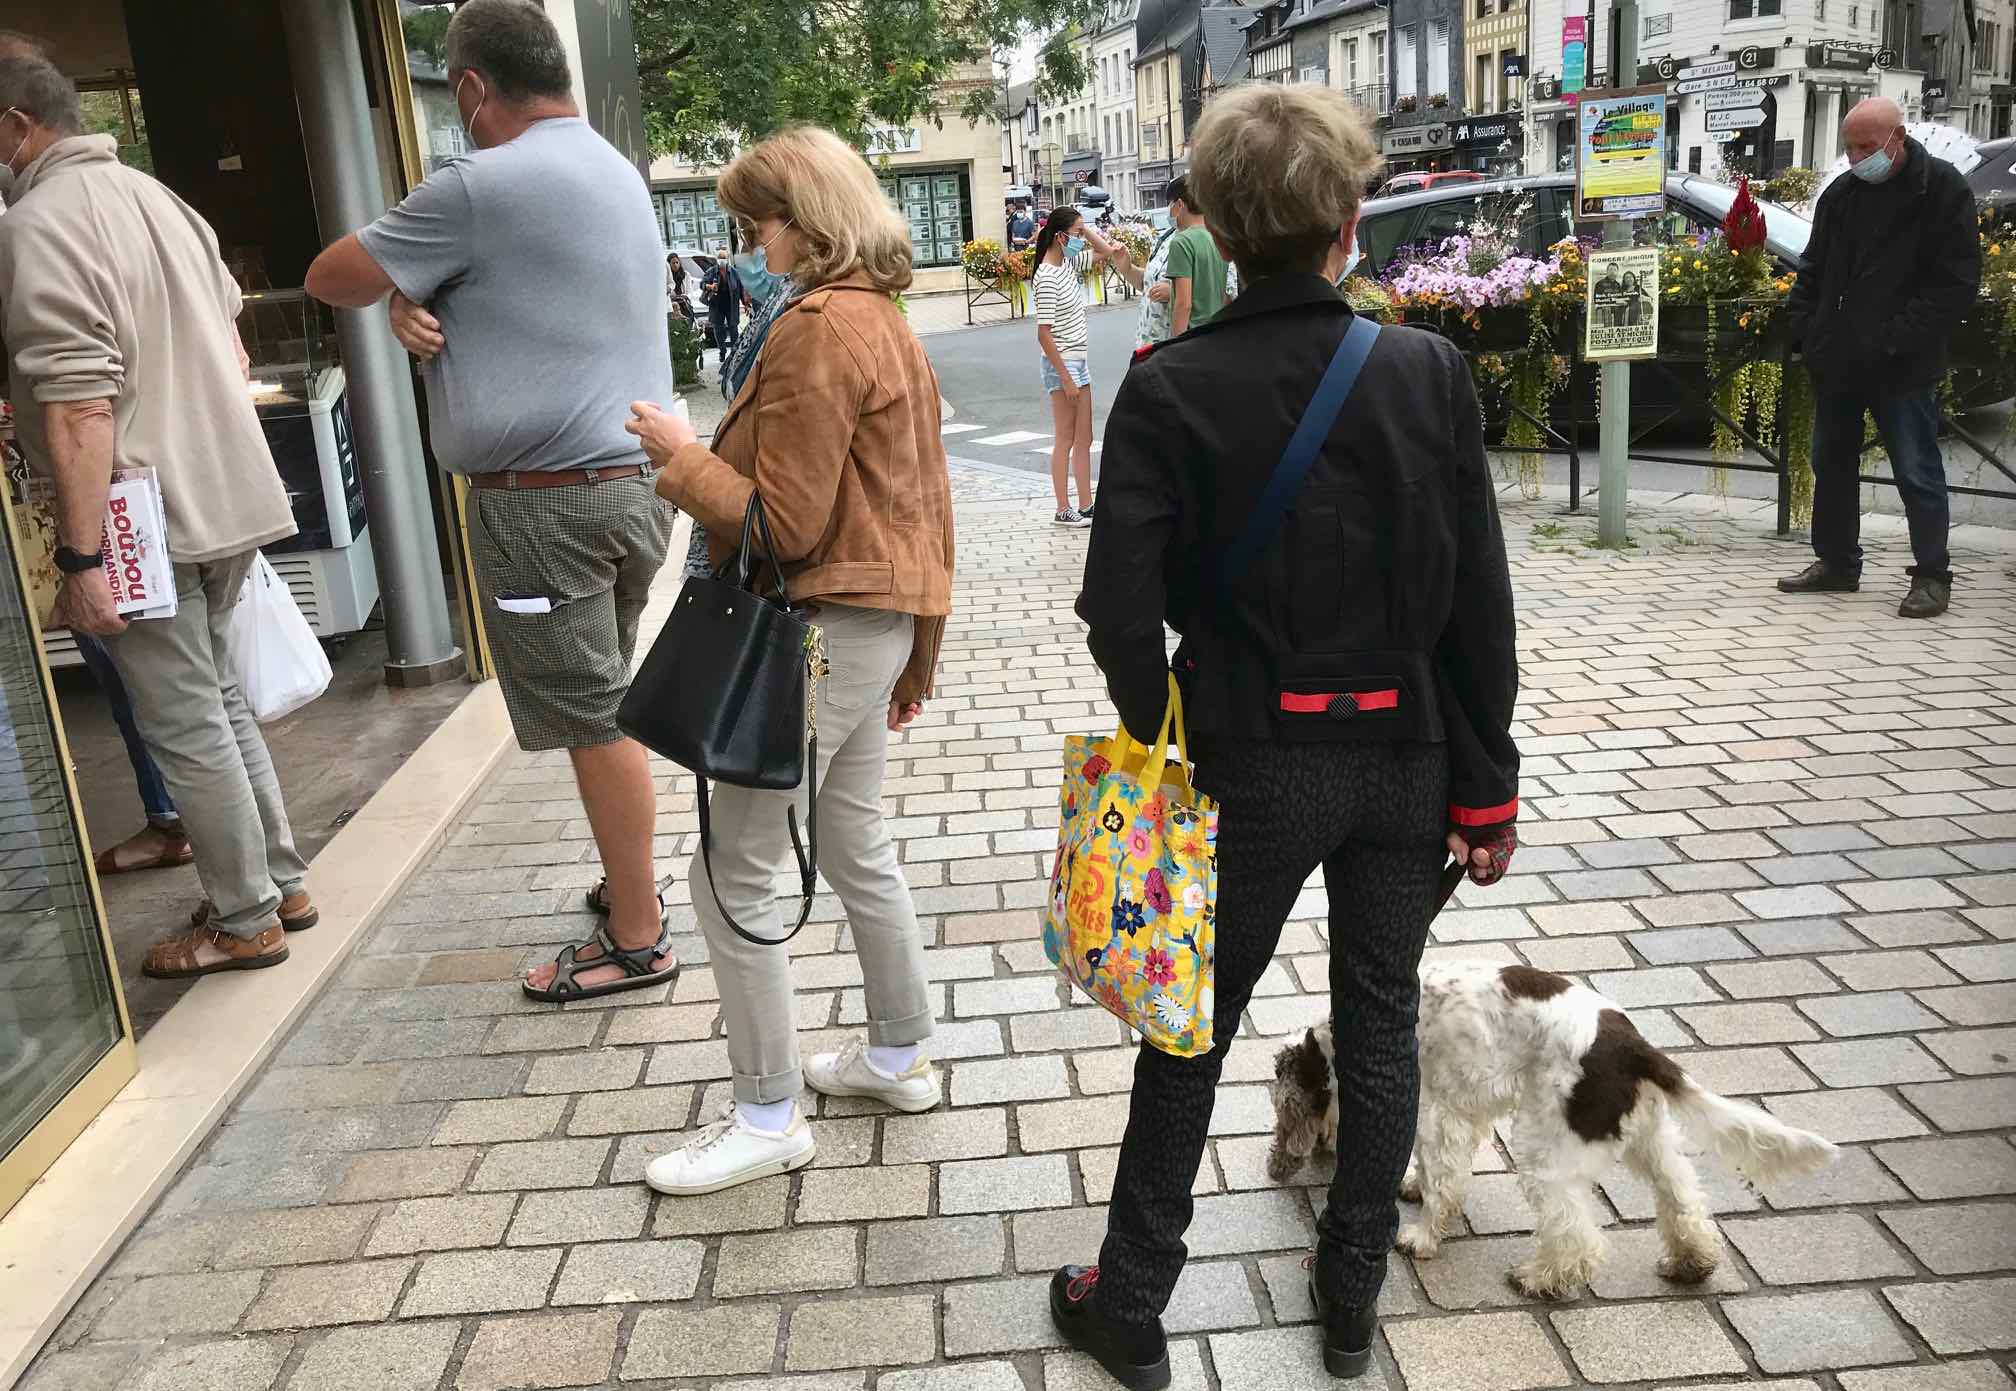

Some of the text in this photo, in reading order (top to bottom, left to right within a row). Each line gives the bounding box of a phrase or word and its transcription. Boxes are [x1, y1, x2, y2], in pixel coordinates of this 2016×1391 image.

[1504, 65, 1519, 74] AXA
[1702, 63, 1733, 75] MELAINE
[1617, 102, 1655, 113] Village
[1456, 124, 1506, 140] AXA Assurance
[109, 496, 147, 601] BOUJOU
